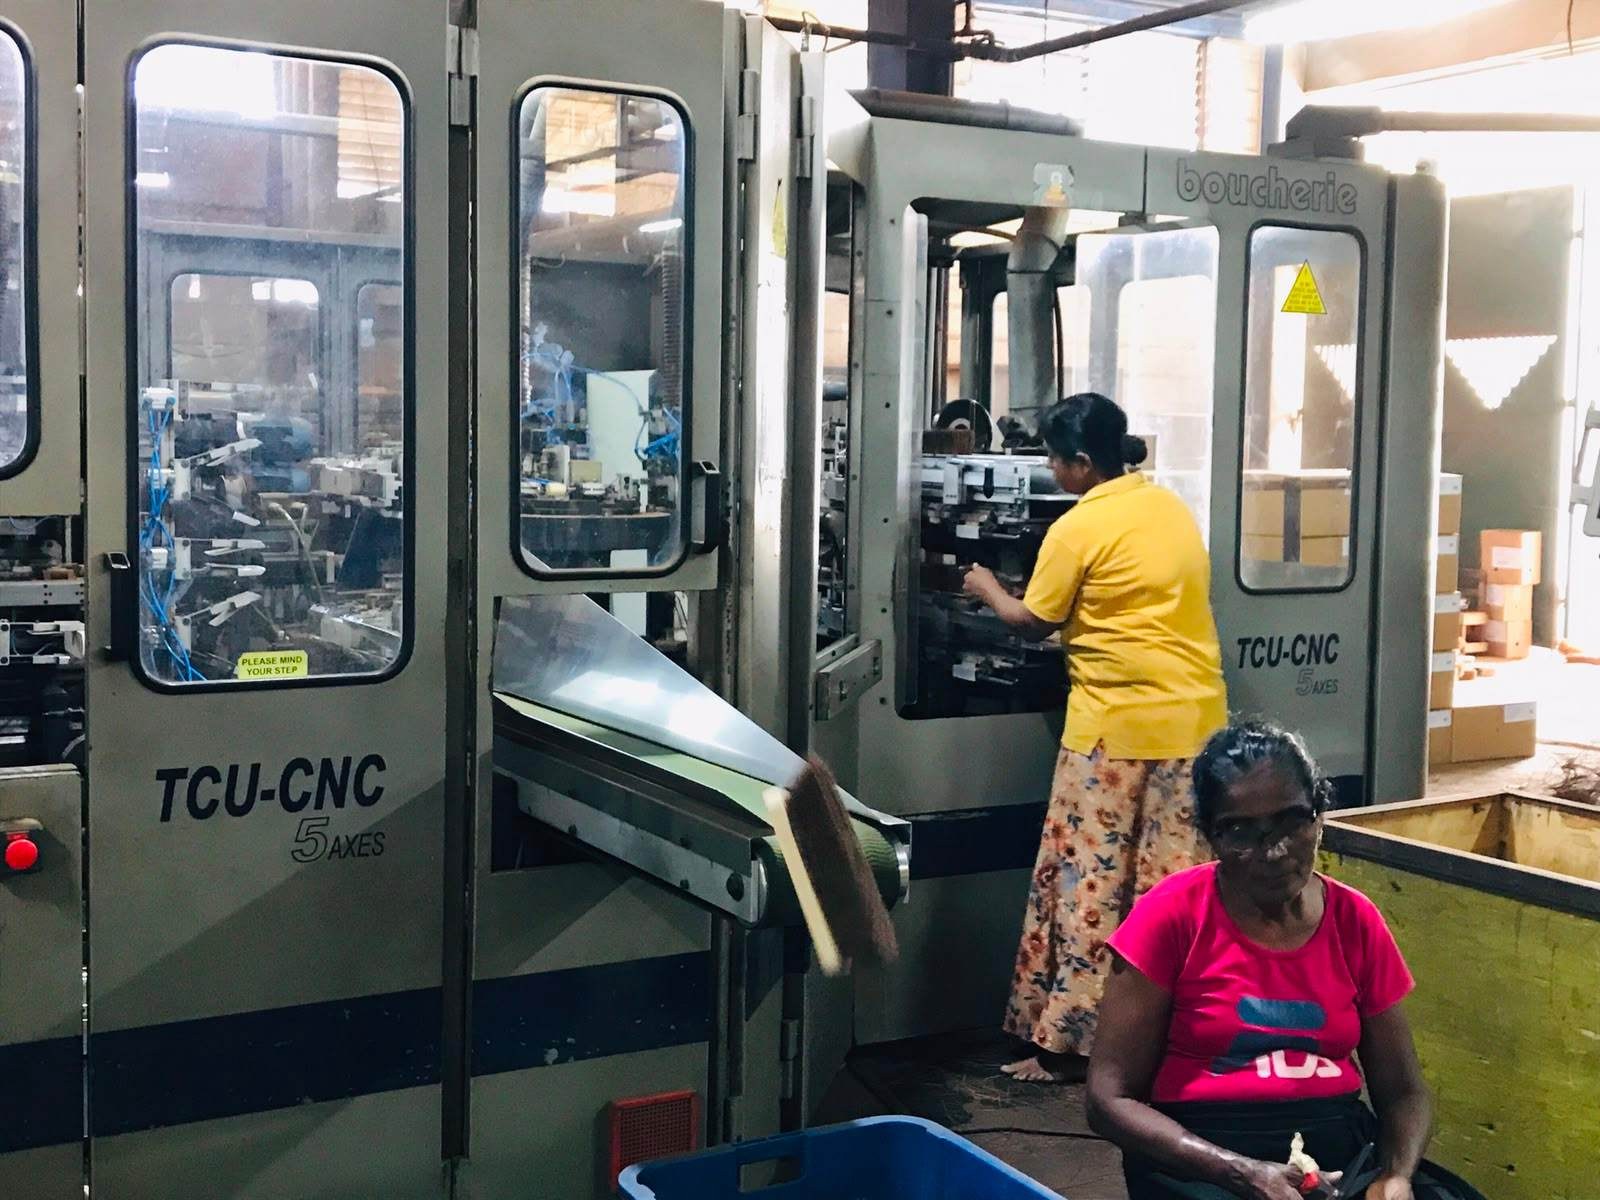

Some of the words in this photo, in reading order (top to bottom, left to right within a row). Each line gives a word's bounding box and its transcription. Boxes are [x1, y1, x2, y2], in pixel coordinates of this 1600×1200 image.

[1176, 157, 1358, 215] boucherie
[241, 657, 278, 666] PLEASE
[280, 655, 303, 664] MIND
[1236, 633, 1340, 669] TCU-CNC
[246, 667, 273, 676] YOUR
[274, 666, 298, 674] STEP
[155, 753, 387, 823] TCU-CNC
